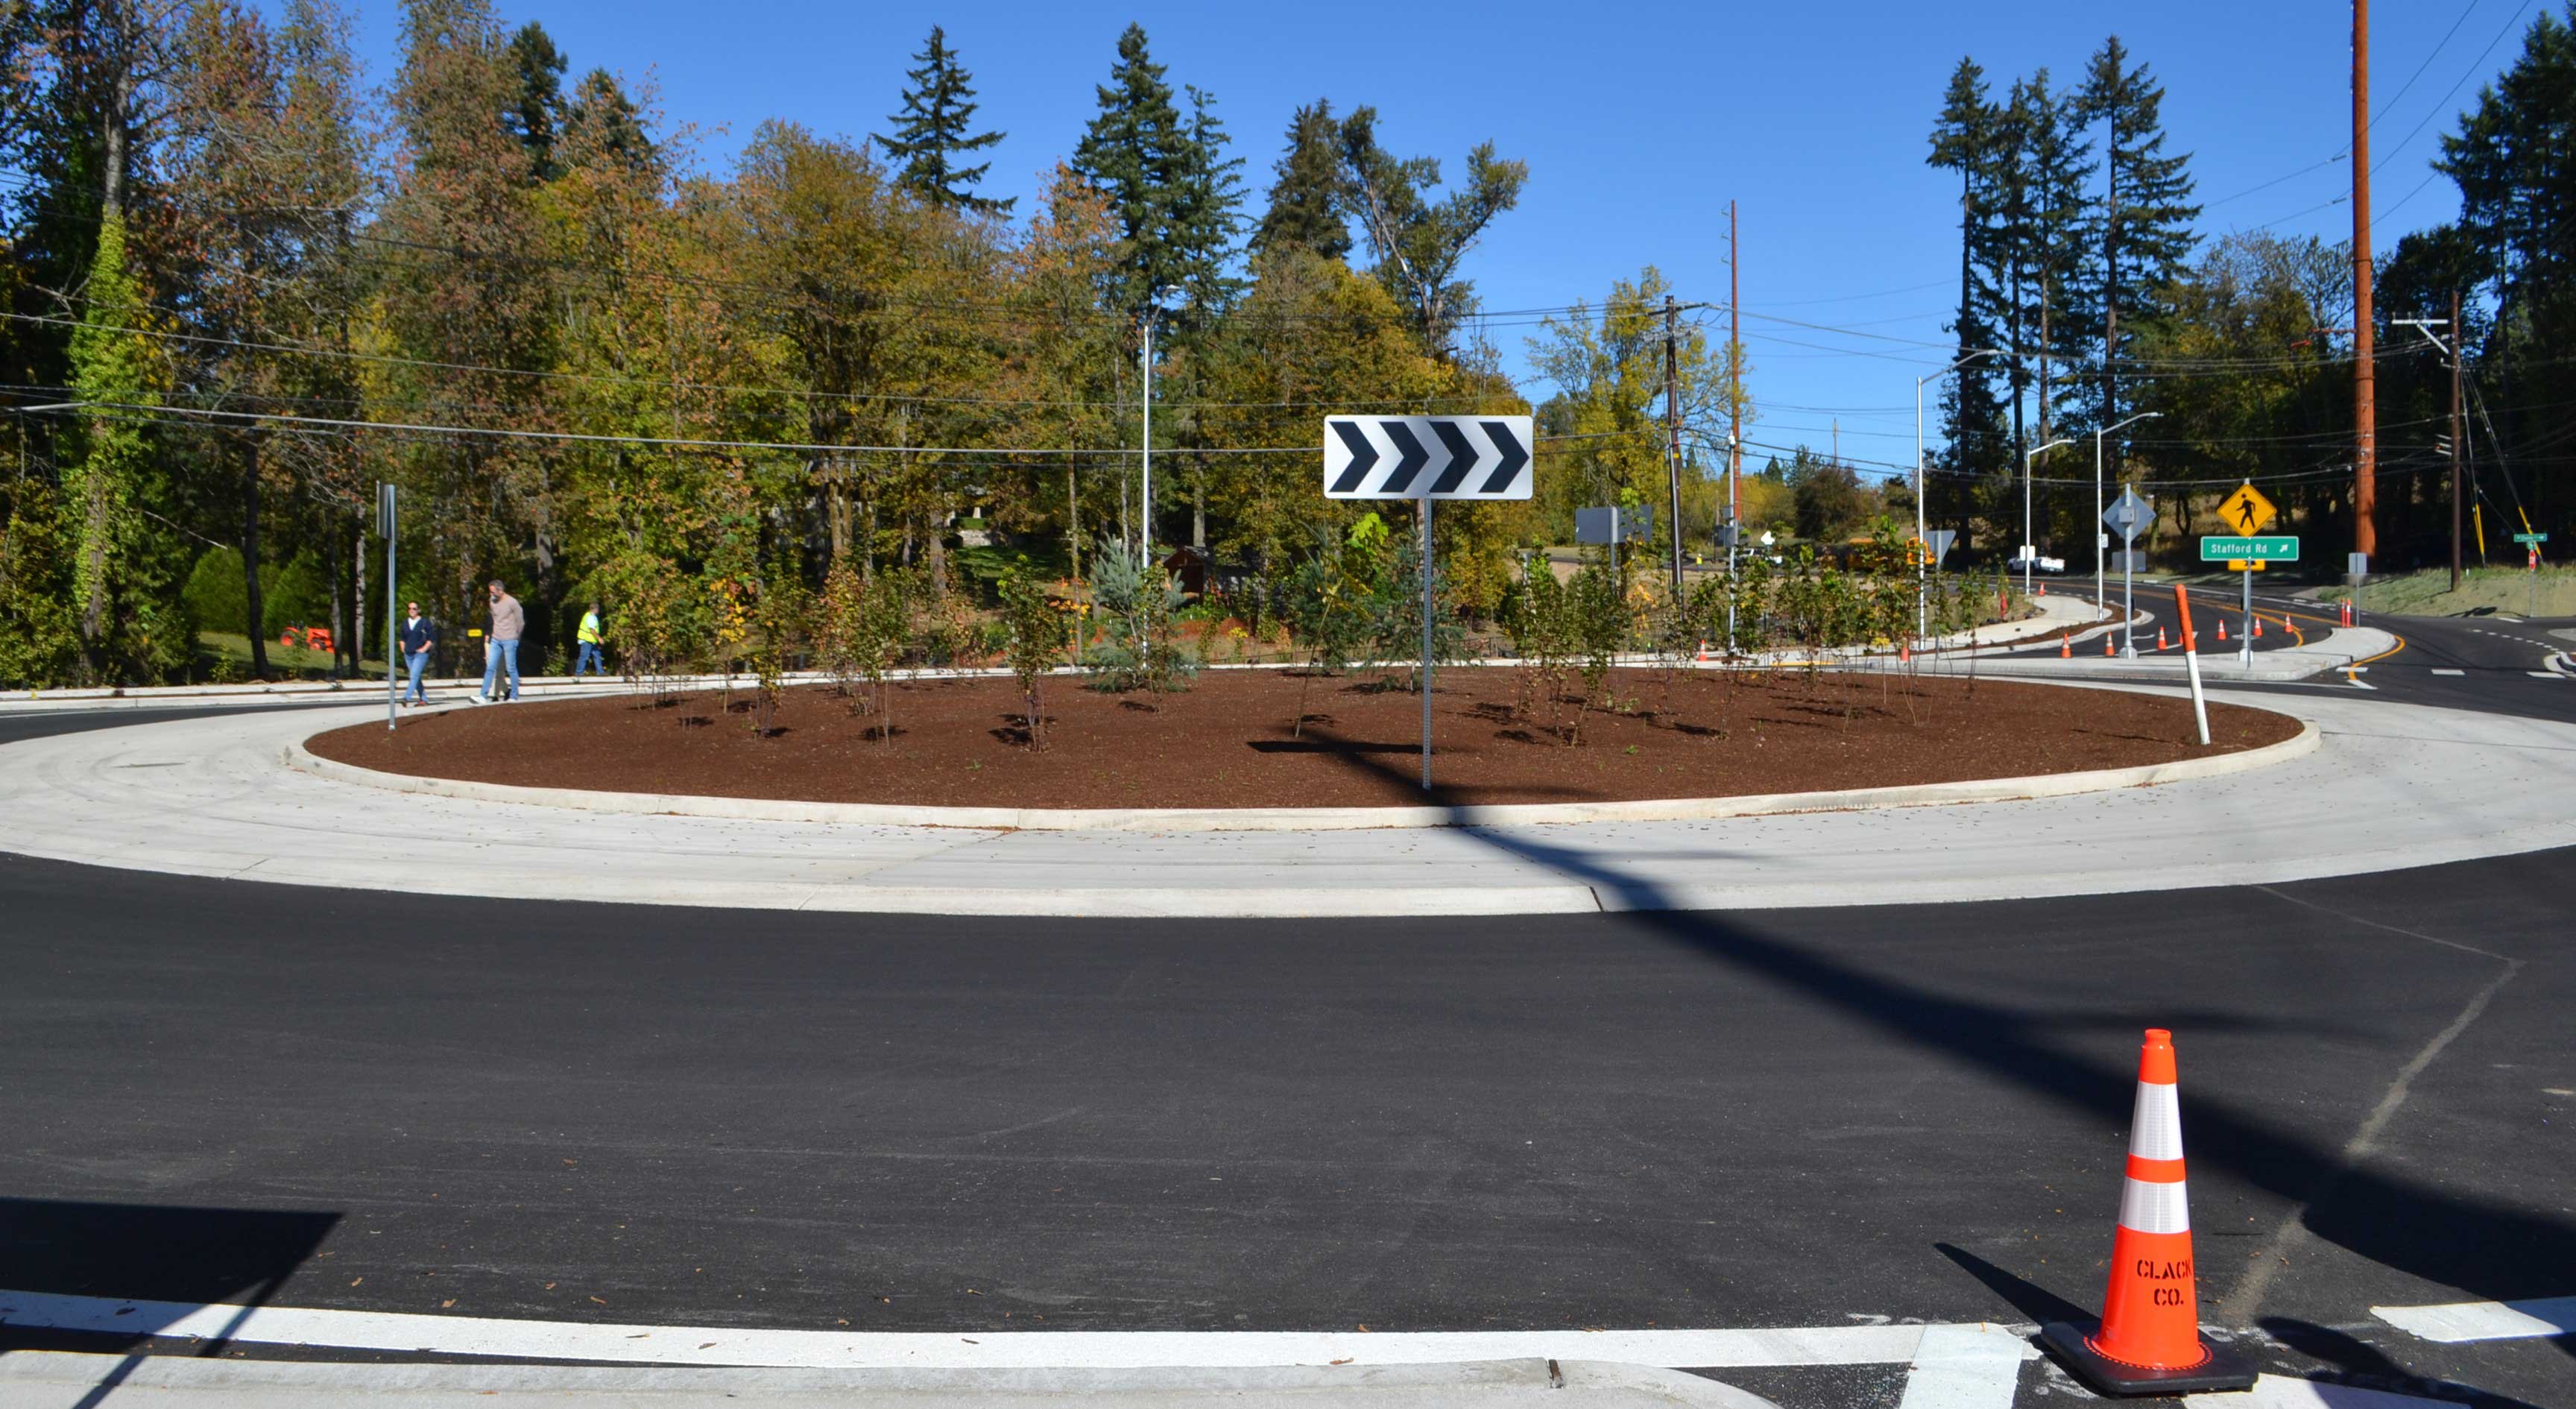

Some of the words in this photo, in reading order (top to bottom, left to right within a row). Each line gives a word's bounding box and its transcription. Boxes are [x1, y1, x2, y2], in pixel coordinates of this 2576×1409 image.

[2211, 543, 2251, 554] Stafford
[2255, 543, 2267, 554] Rd
[2153, 1288, 2184, 1306] CO.
